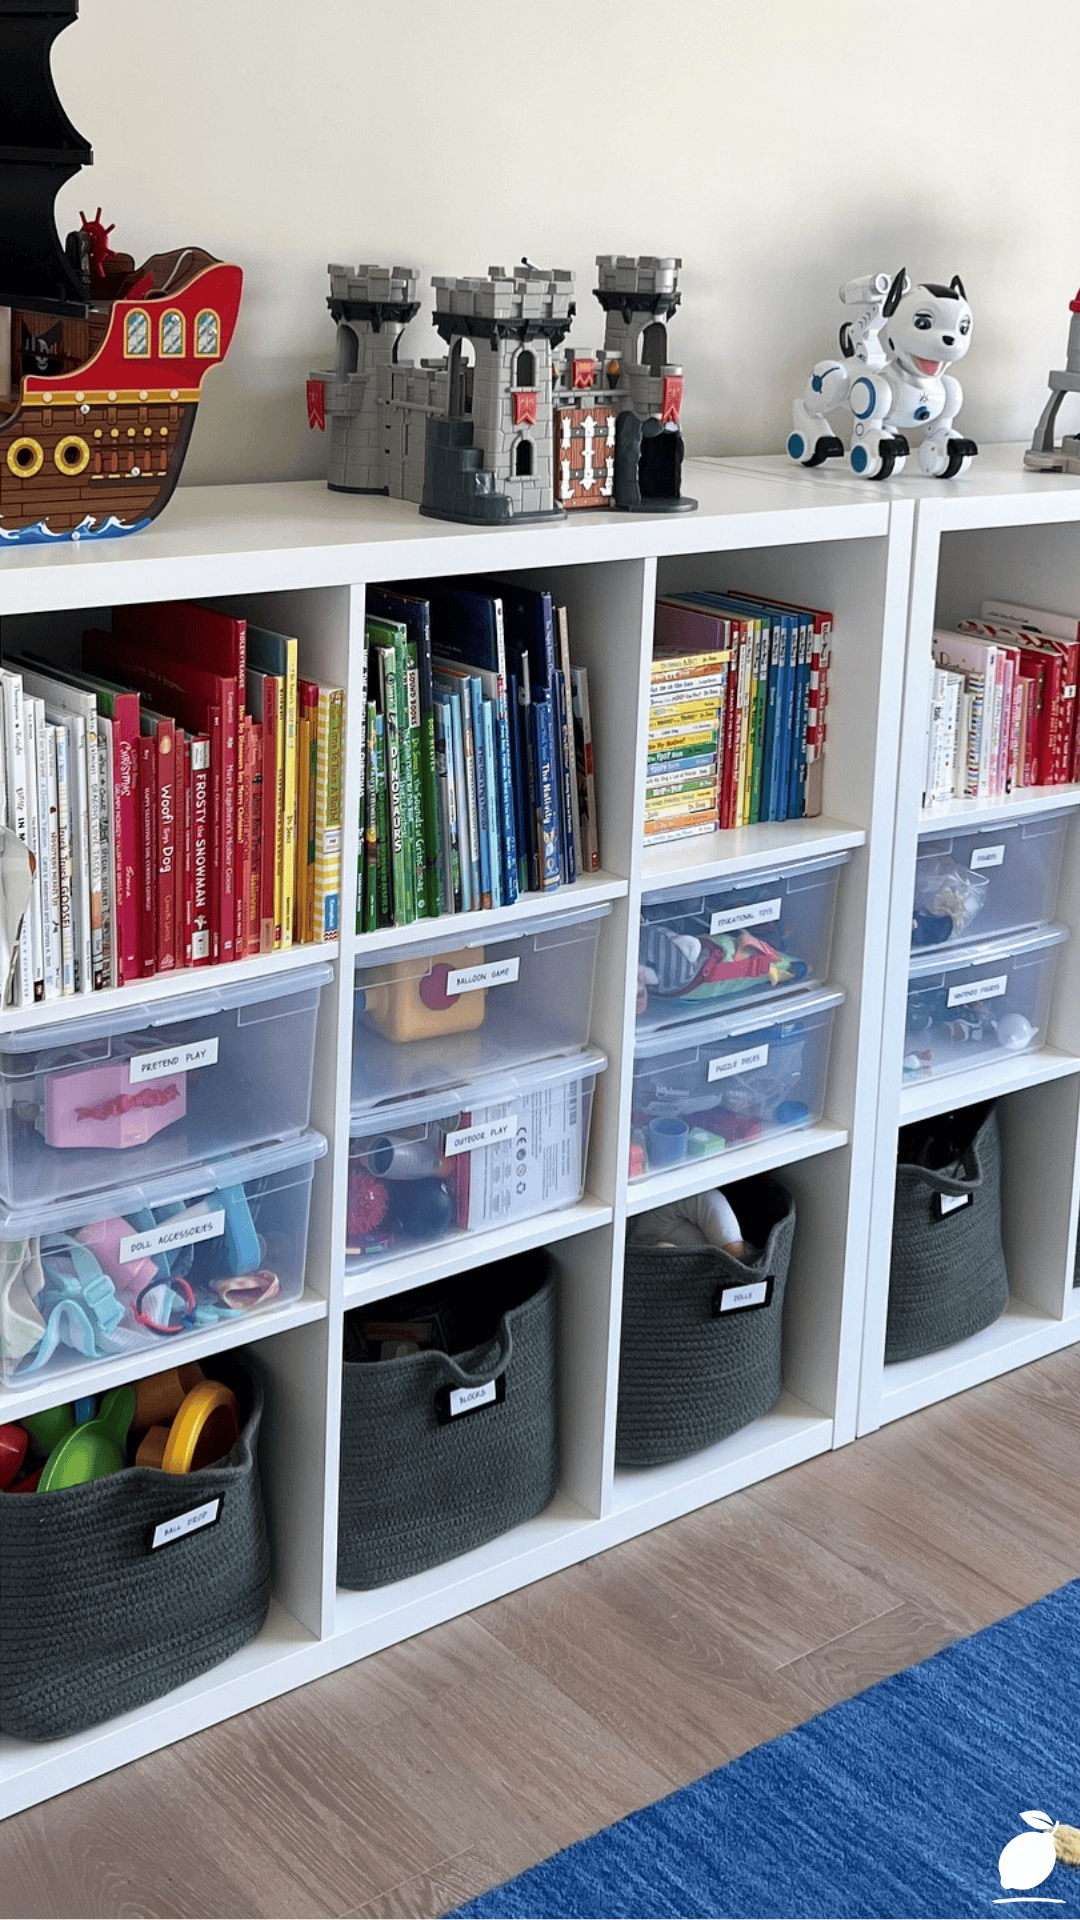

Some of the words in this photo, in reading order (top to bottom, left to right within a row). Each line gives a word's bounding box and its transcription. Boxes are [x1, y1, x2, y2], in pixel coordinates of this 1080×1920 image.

[409, 671, 417, 698] SOUND
[409, 700, 418, 726] BOOKS
[238, 723, 245, 734] Do
[15, 731, 23, 756] Knight
[226, 764, 234, 785] Mary
[541, 762, 550, 781] The
[91, 783, 99, 820] DRAGONS
[161, 784, 174, 824] Woof!
[195, 773, 206, 823] FROSTY
[237, 784, 245, 805] Merry
[391, 746, 402, 854] DINOSAURS
[541, 783, 553, 824] Nativity
[18, 817, 25, 828] IN
[225, 787, 234, 835] Engelbreit's
[286, 815, 294, 825] Dr.
[414, 792, 424, 829] Sounds
[41, 822, 49, 848] Tradition
[59, 825, 67, 850] Truck
[92, 823, 100, 845] LOVE
[197, 824, 205, 838] the
[159, 846, 174, 873] Dog
[225, 836, 233, 866] Mother
[60, 856, 68, 881] Truck
[92, 851, 101, 879] TACOS
[195, 839, 206, 908] SNOWMAN
[225, 867, 233, 894] Goose
[61, 885, 70, 929] GOOSE!
[718, 913, 754, 927] EDUCATIONAL
[759, 907, 773, 918] TOYS
[456, 972, 487, 986] BALLOON
[491, 967, 510, 979] GAME
[141, 1056, 179, 1073] PRETEND
[185, 1049, 207, 1062] PLAY
[716, 1060, 738, 1073] PUZZLE
[454, 1130, 486, 1147] OUTDOOR
[490, 1125, 508, 1137] PLAY
[130, 1240, 152, 1253] DOLL
[158, 1222, 214, 1245] ACCESSORIES
[734, 1292, 752, 1302] DOLLS
[459, 1388, 486, 1404] BLOCKS
[164, 1524, 182, 1537] BALL
[187, 1511, 208, 1526] DROP
